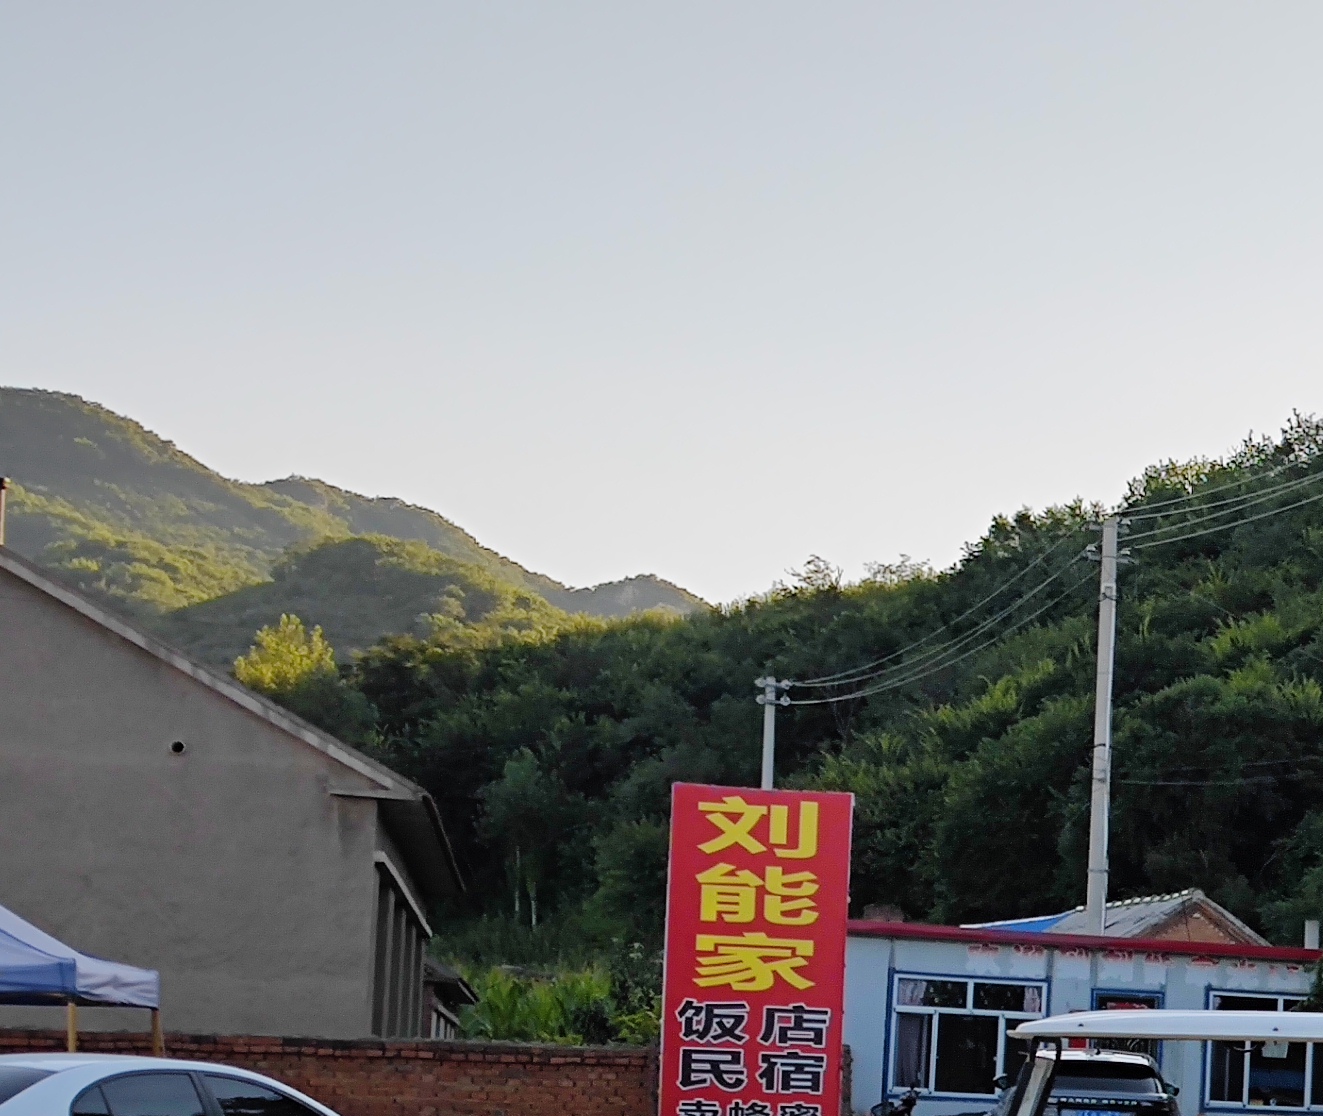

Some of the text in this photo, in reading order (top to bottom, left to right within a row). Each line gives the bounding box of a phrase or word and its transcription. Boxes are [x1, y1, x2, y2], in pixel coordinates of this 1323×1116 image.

[692, 795, 820, 992] 刘能家
[676, 998, 831, 1048] 饭店
[676, 1048, 827, 1095] 民宿
